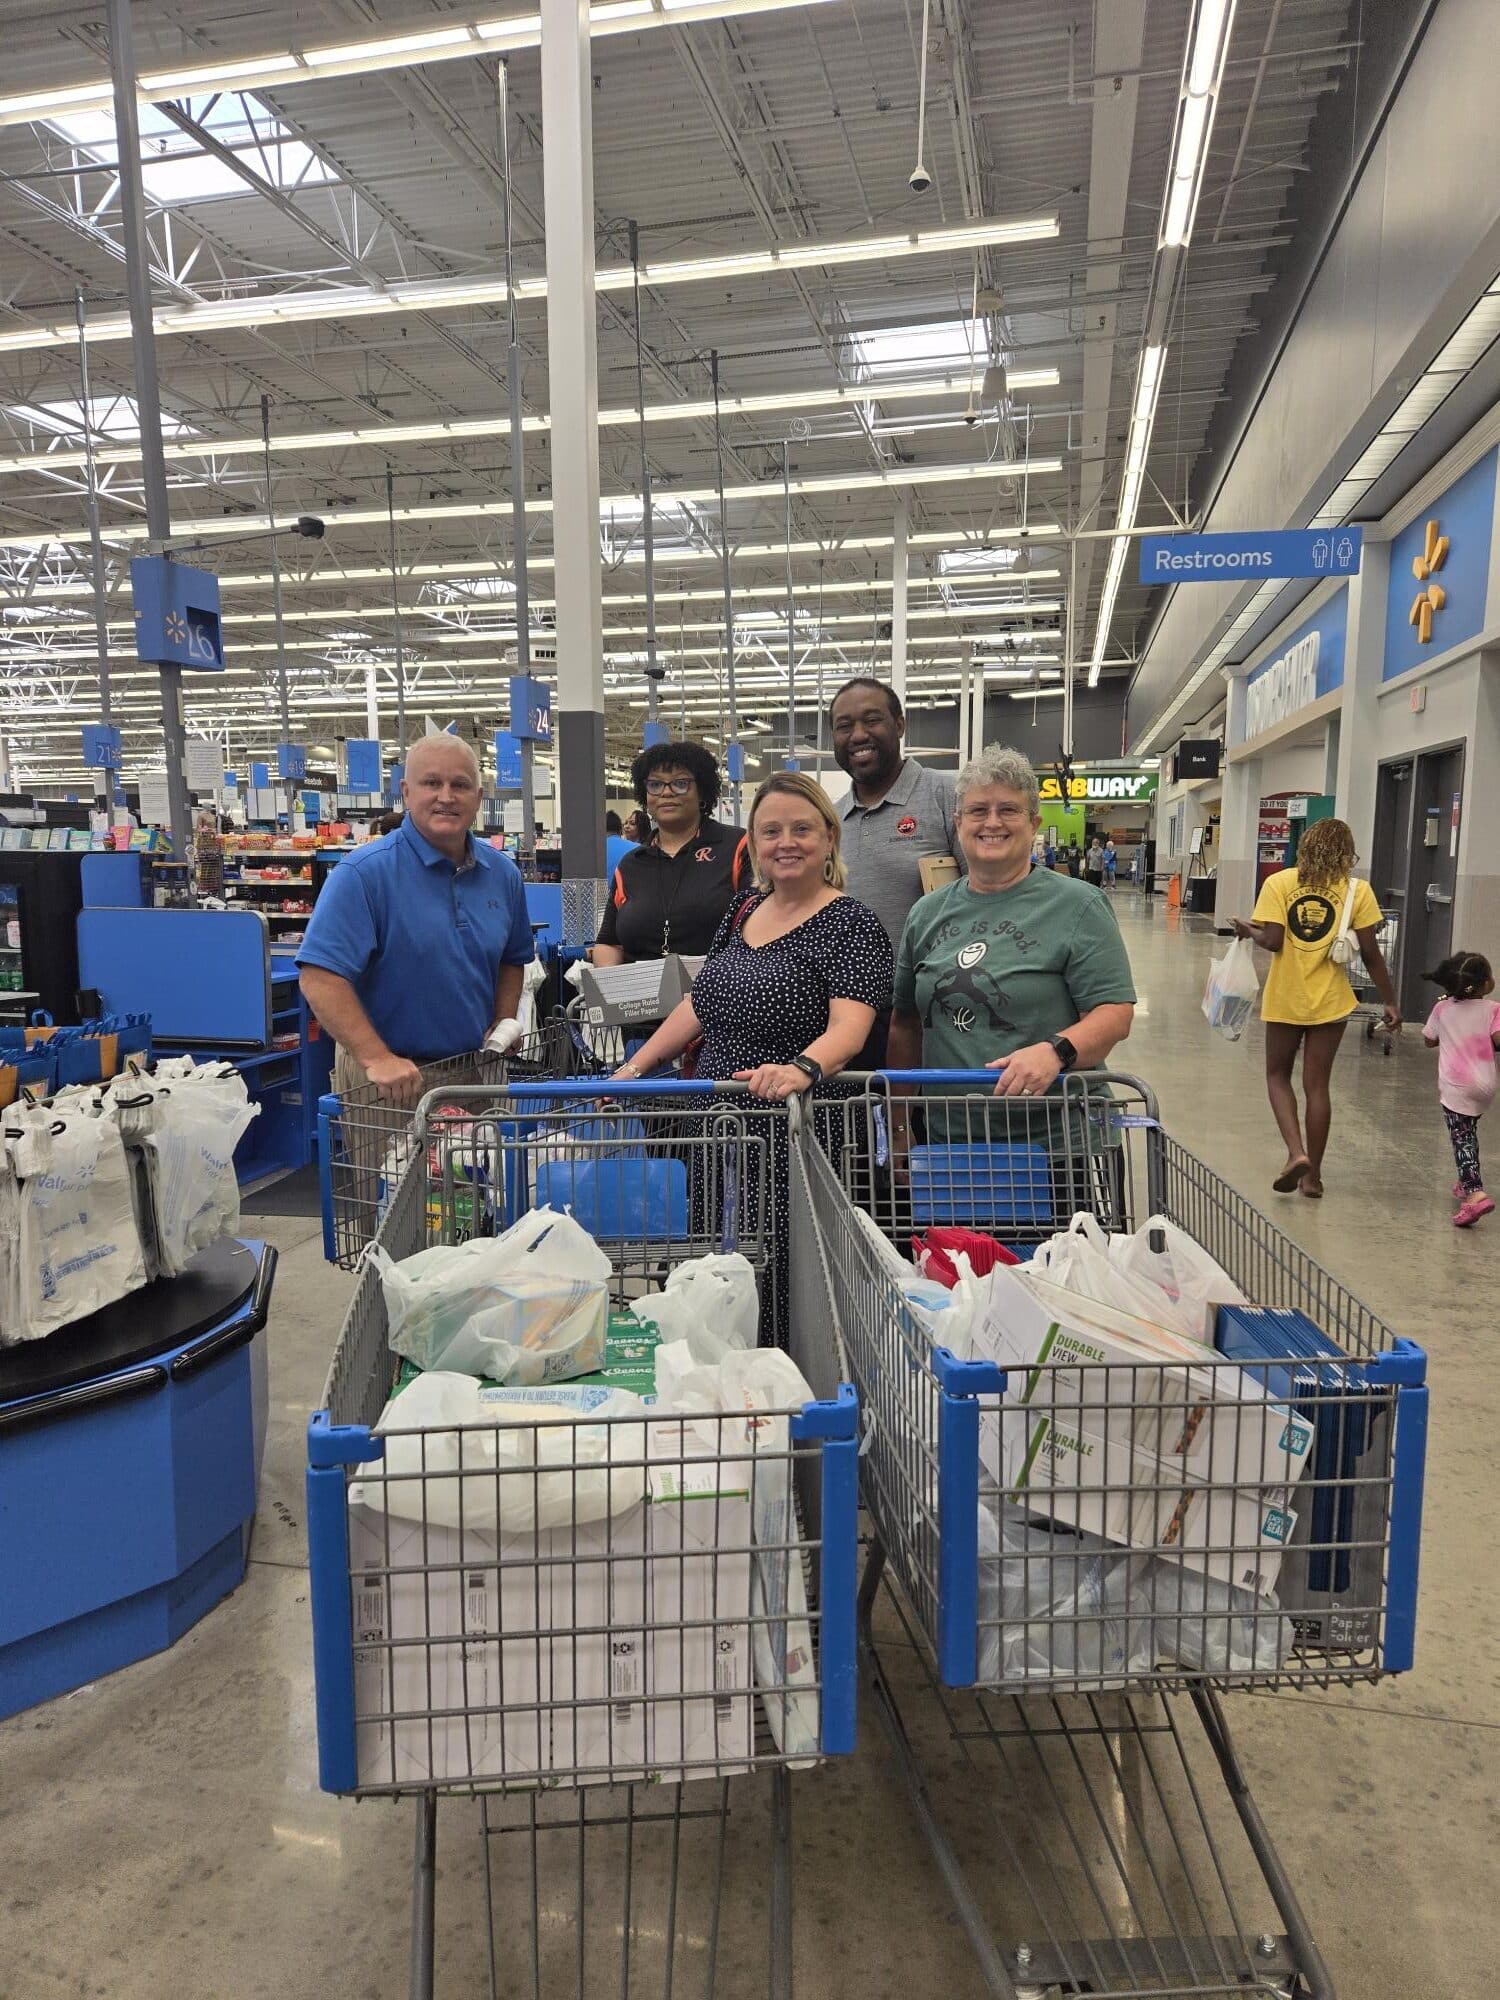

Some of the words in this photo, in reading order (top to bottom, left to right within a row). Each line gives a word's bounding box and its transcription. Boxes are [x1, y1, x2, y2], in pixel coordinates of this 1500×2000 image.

[1155, 550, 1273, 570] Restrooms
[187, 625, 216, 660] 26
[536, 707, 549, 735] 24
[97, 745, 111, 764] 21
[1039, 776, 1149, 799] SUBWAY
[695, 847, 717, 862] R
[1288, 887, 1341, 905] VOLUNTEER
[970, 920, 988, 934] is
[642, 999, 660, 1007] Ruled
[624, 1010, 640, 1018] Filler
[641, 1008, 659, 1016] Paper
[1051, 1346, 1079, 1364] VIEW
[1057, 1334, 1106, 1362] DURABLE
[1041, 1442, 1067, 1460] VIW
[1331, 1616, 1368, 1629] Paper
